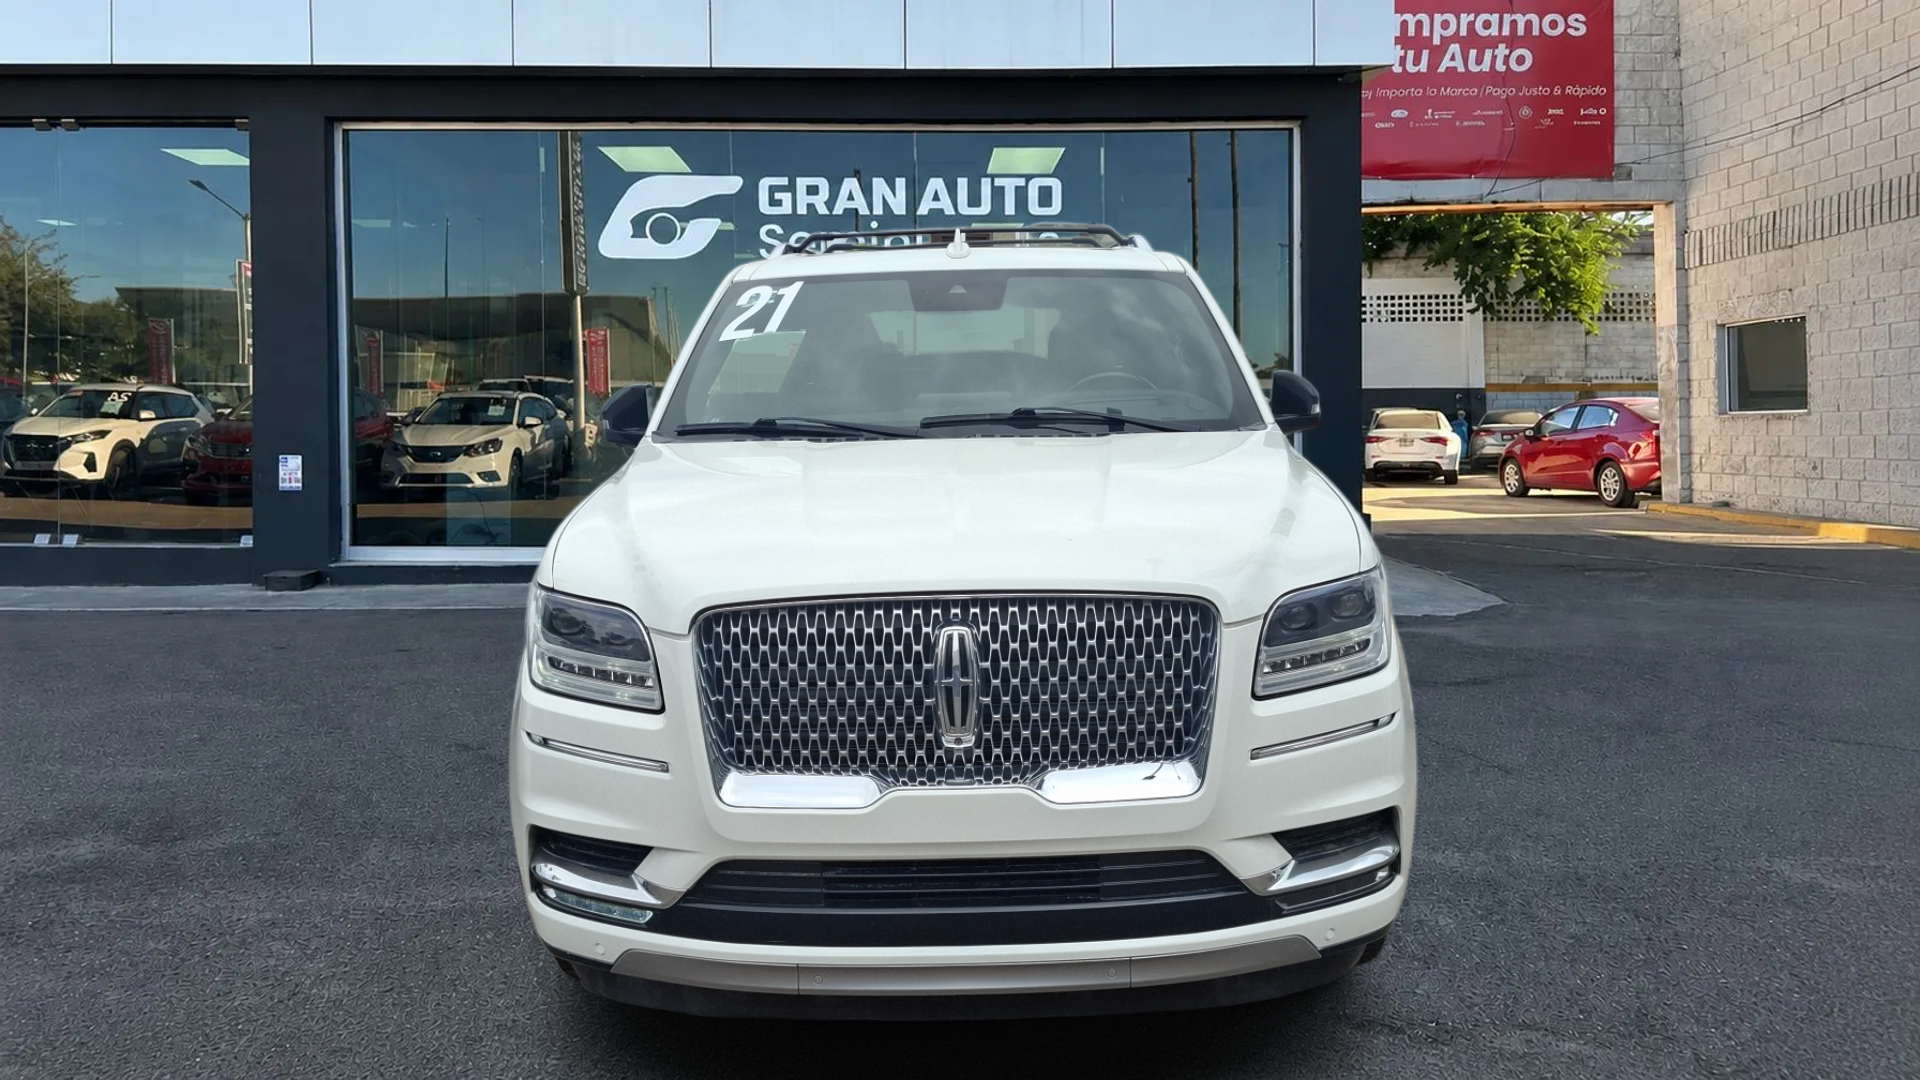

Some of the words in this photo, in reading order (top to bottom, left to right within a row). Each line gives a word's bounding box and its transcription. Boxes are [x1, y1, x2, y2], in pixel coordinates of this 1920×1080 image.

[1392, 44, 1429, 73] tu
[1437, 43, 1534, 73] Auto
[1376, 87, 1423, 99] Importa
[1426, 86, 1437, 96] la
[1440, 86, 1478, 97] Marca
[1519, 86, 1550, 96] Justo
[1553, 85, 1562, 96] &
[1565, 84, 1607, 98] Rápido
[758, 177, 907, 215] GRAN
[917, 177, 1063, 216] AUTO
[718, 281, 804, 342] 21
